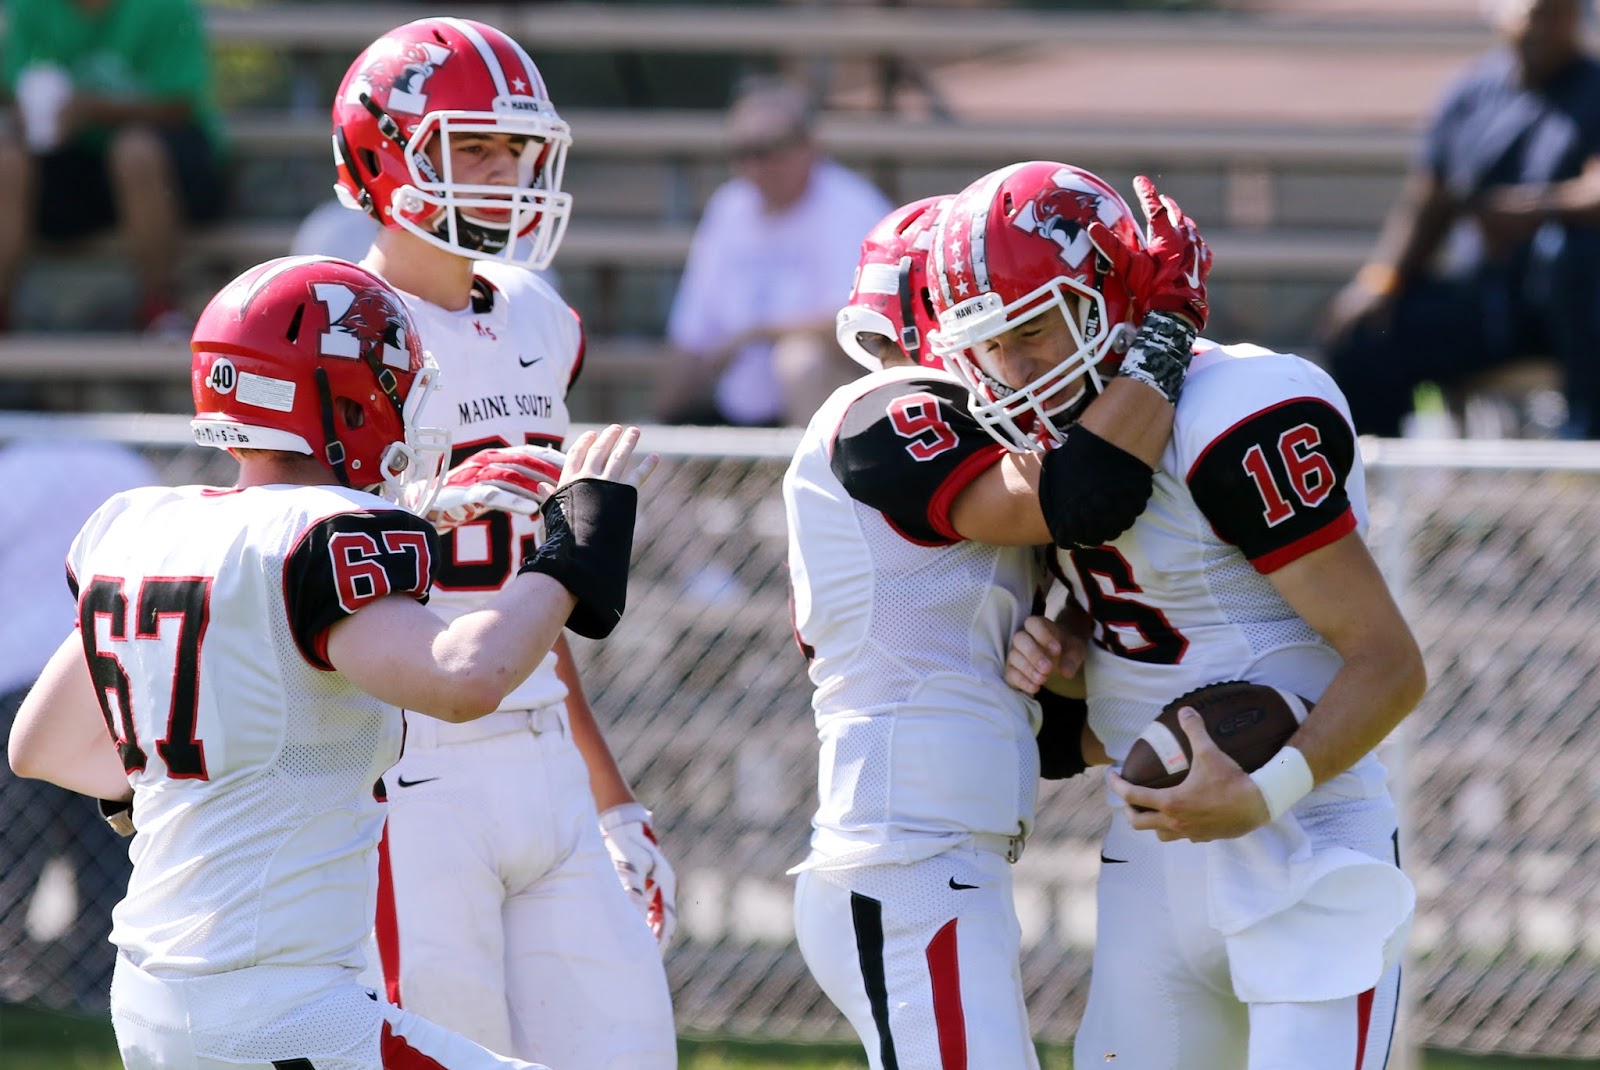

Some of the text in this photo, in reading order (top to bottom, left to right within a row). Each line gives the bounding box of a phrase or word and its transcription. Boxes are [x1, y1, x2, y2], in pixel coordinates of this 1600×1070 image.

[955, 301, 984, 320] HAWKS
[212, 364, 233, 389] 40
[458, 394, 552, 426] MAINE SOUTH
[886, 391, 960, 462] 9
[1242, 422, 1336, 528] 16
[327, 530, 431, 614] 67
[78, 574, 214, 781] 67
